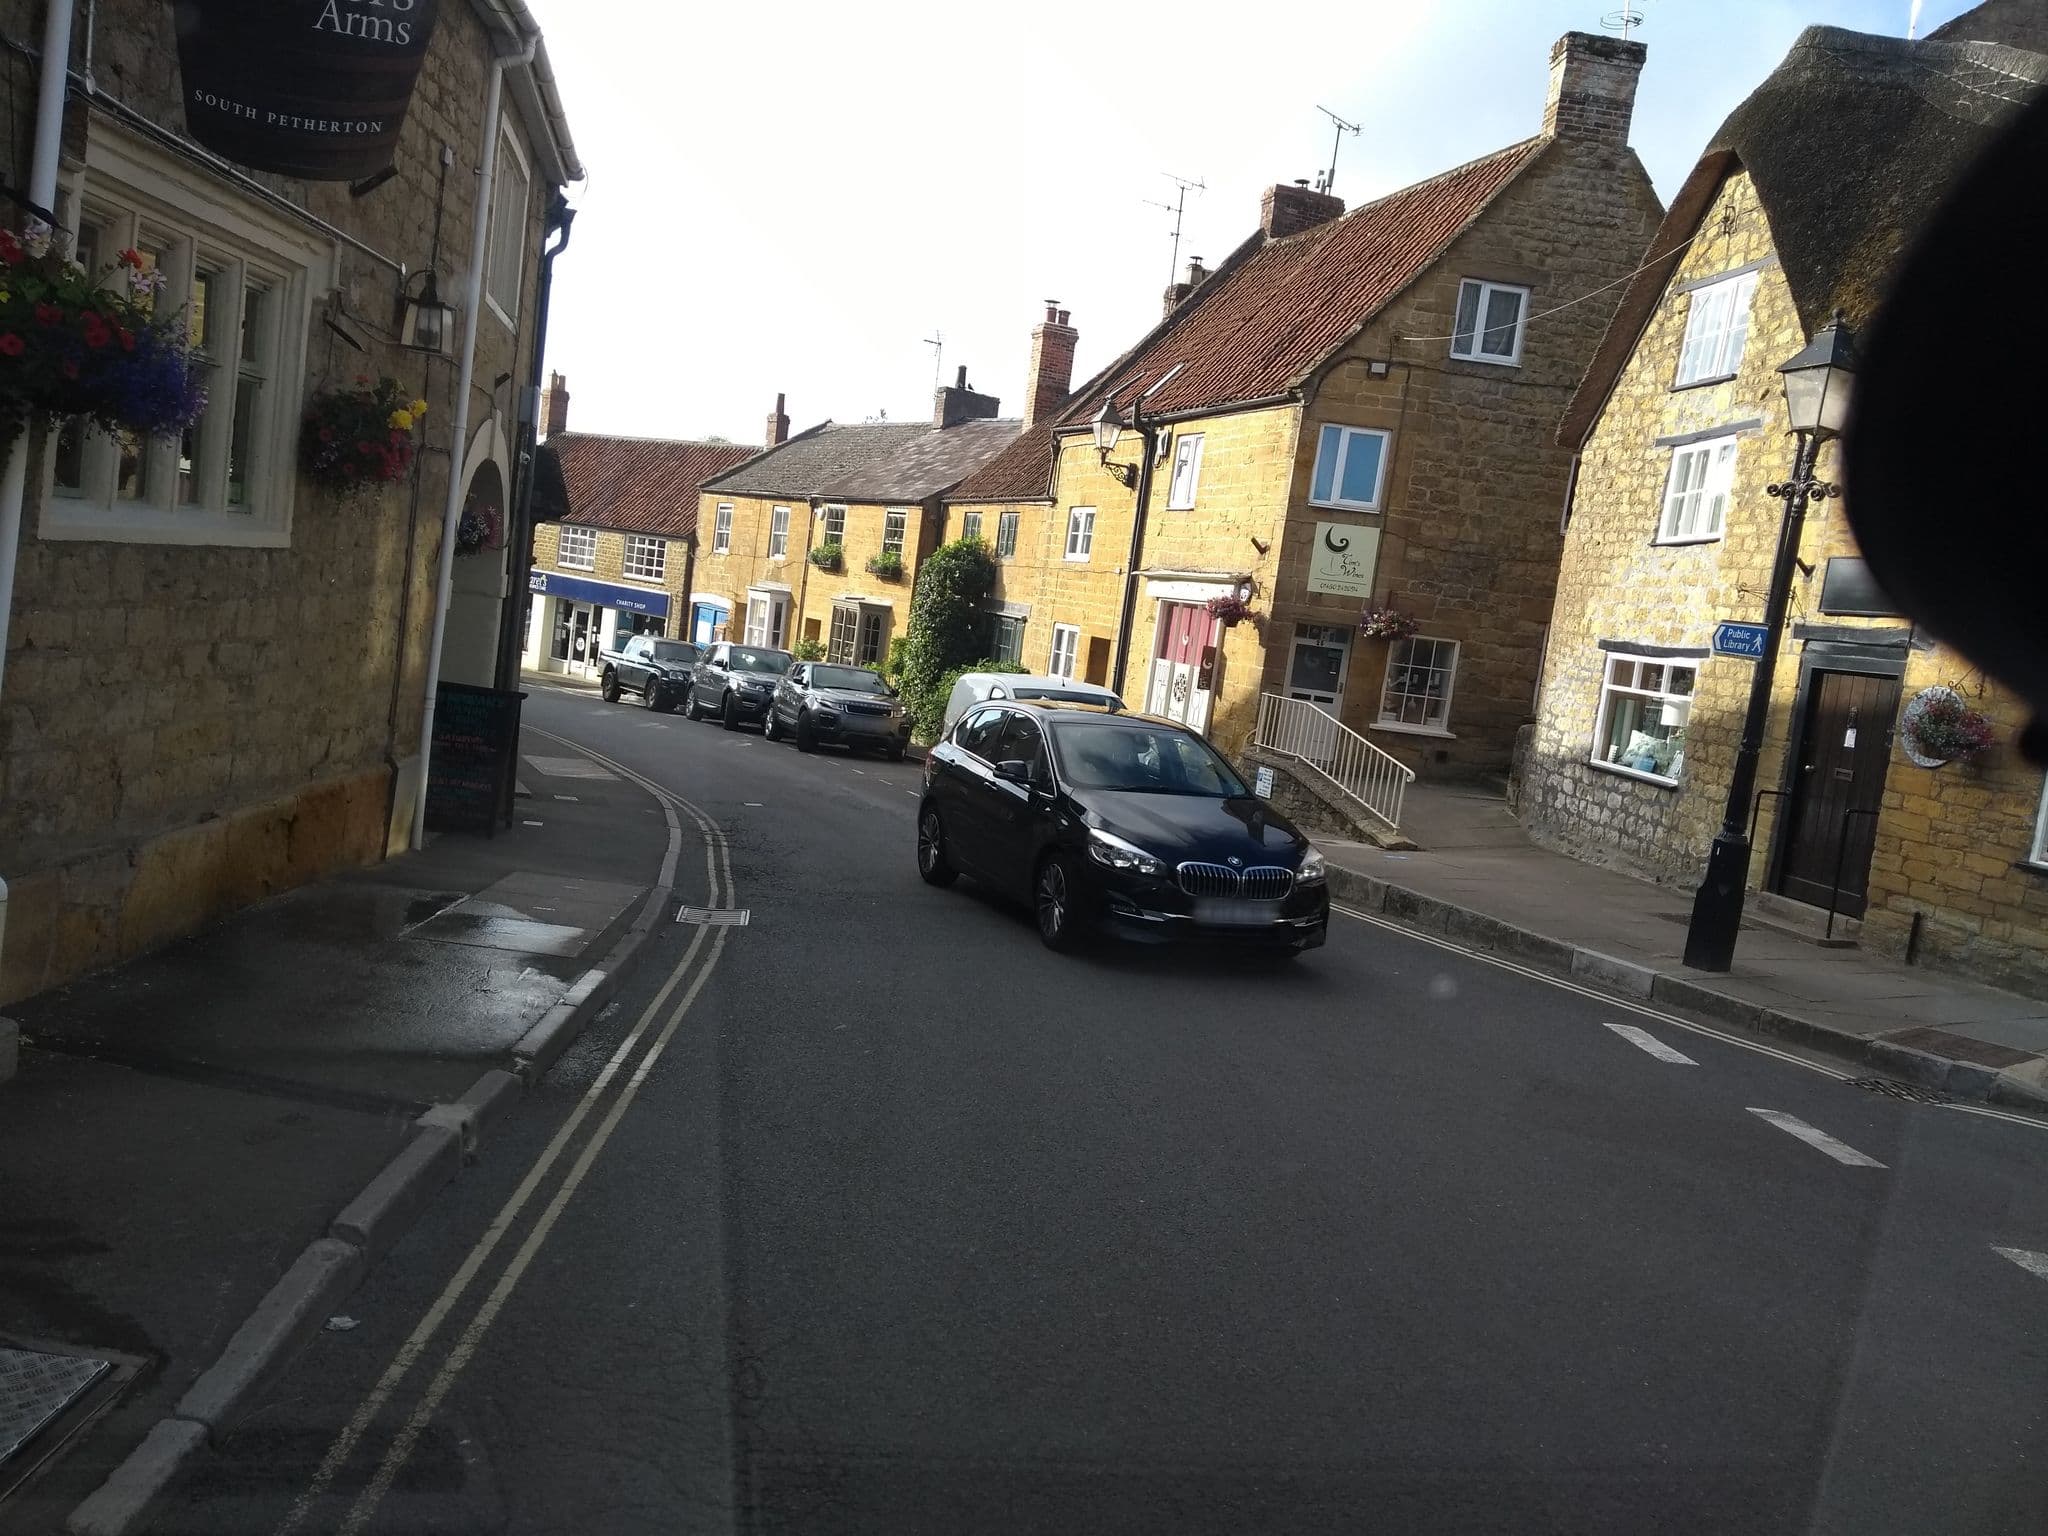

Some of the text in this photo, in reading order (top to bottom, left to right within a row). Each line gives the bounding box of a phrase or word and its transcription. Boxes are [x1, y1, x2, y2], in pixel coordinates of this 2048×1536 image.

[312, 0, 411, 45] Arms
[195, 90, 383, 133] SOUTH PETHERTON
[1340, 565, 1365, 579] Wines
[616, 599, 634, 607] CHARITY
[1727, 628, 1751, 640] Public
[1723, 638, 1751, 652] Library
